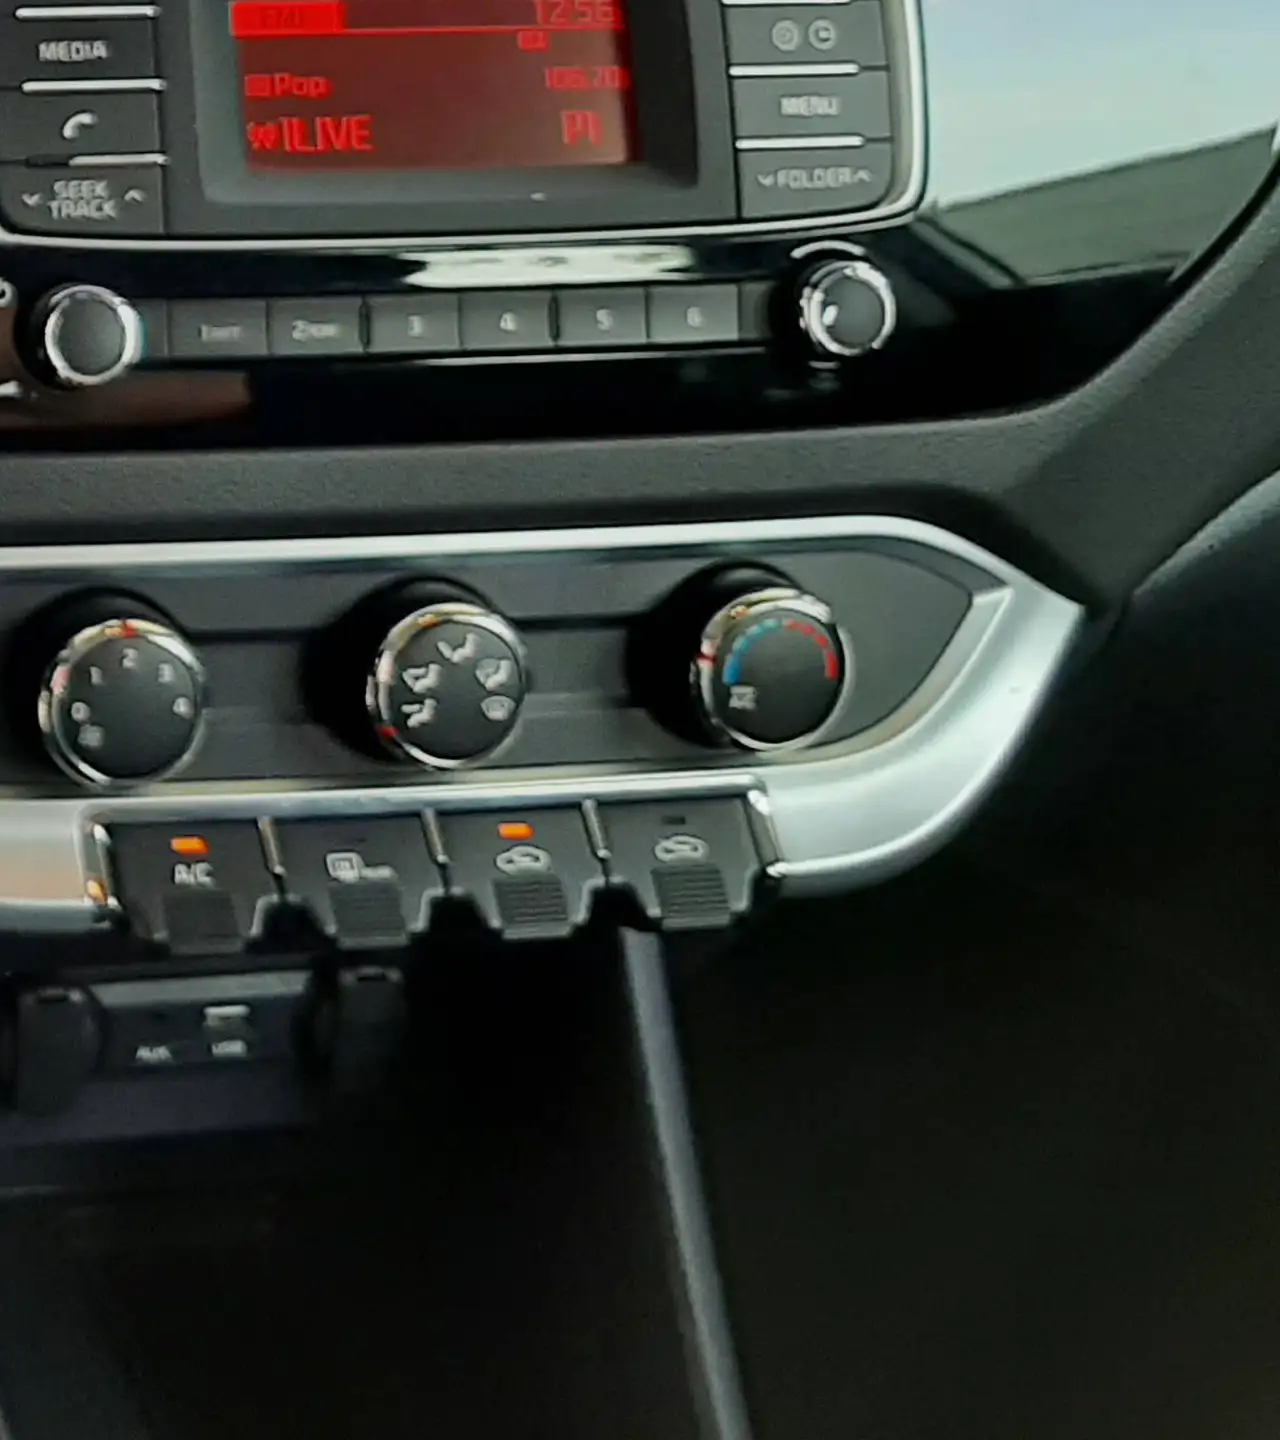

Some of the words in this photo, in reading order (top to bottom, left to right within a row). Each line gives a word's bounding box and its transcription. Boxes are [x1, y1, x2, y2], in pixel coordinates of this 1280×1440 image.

[38, 41, 109, 61] MEDIA
[274, 73, 330, 97] Pop
[781, 96, 839, 116] MENU
[777, 167, 853, 189] FOLDER
[53, 180, 108, 199] SEEK
[48, 199, 117, 220] TRACK
[122, 648, 139, 668] 2
[174, 863, 216, 886] A/C
